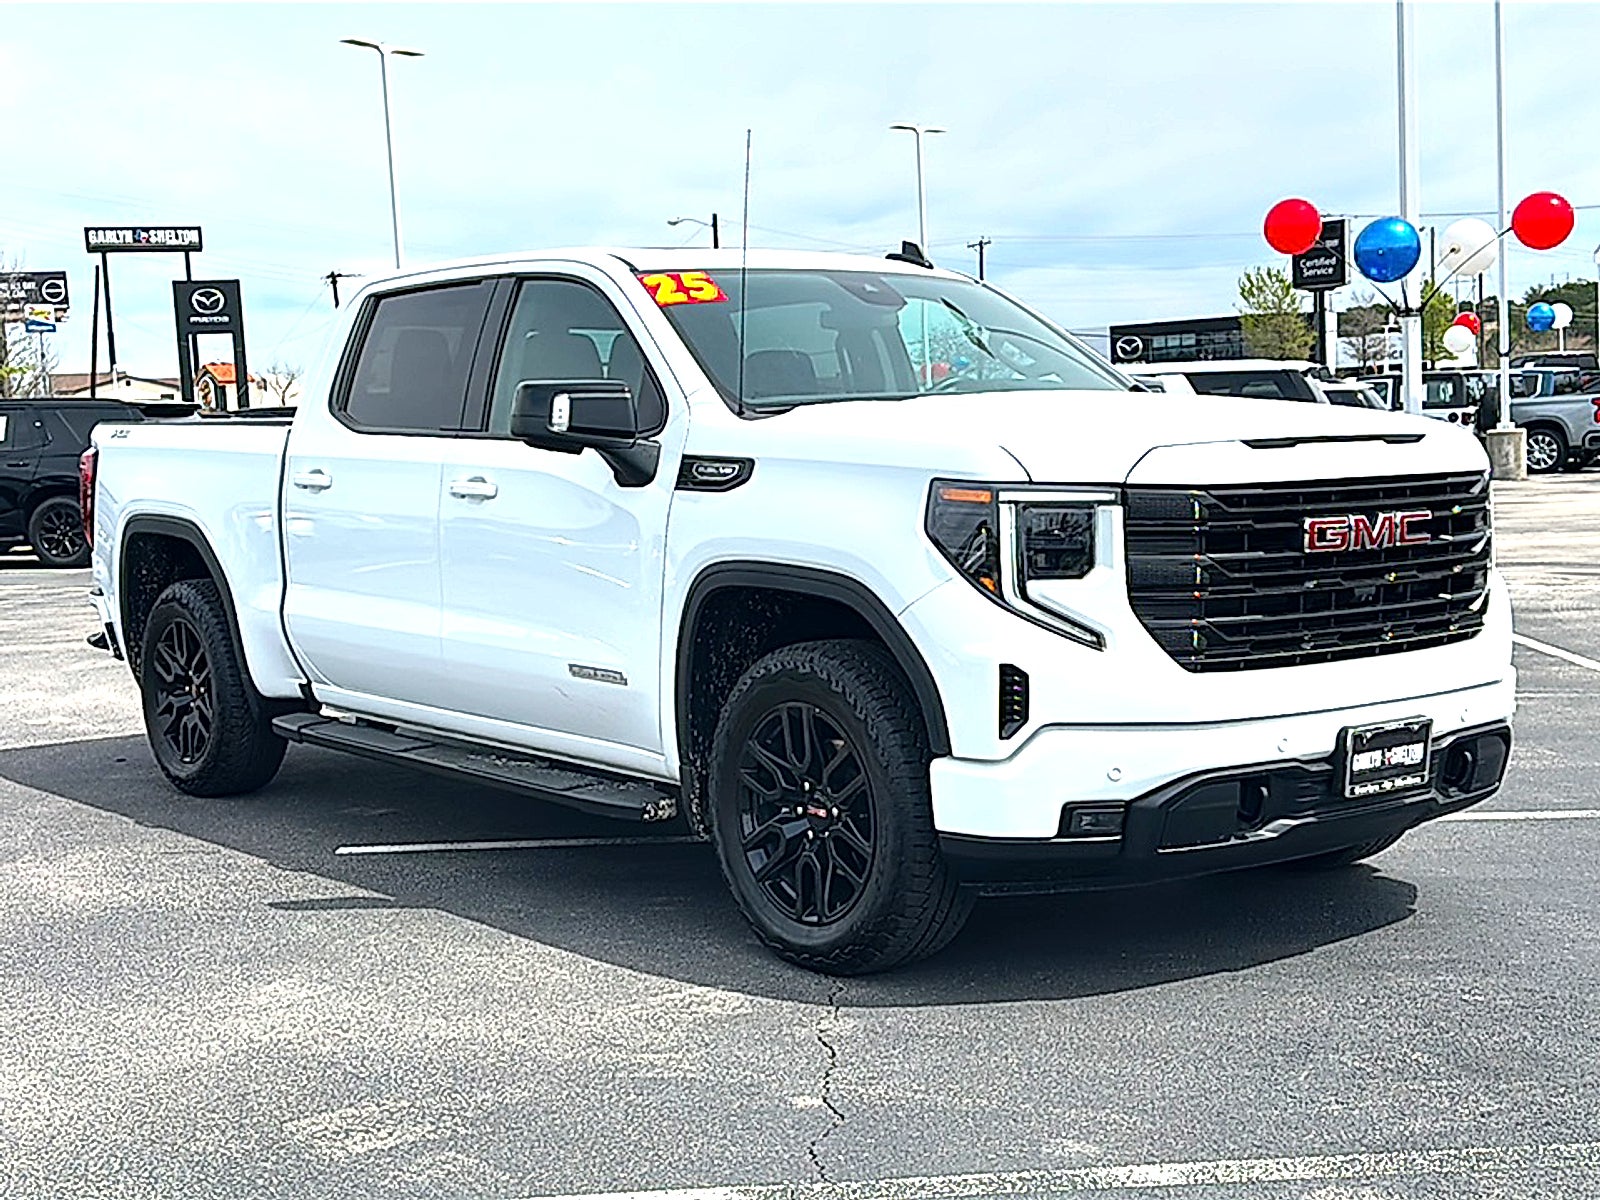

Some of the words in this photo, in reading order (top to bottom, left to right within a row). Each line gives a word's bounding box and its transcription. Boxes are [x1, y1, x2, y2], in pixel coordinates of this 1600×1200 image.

[148, 229, 199, 245] SHELTON
[1300, 256, 1337, 268] Certified
[1303, 267, 1334, 278] Service
[643, 271, 718, 304] 25
[1303, 510, 1432, 553] GMC
